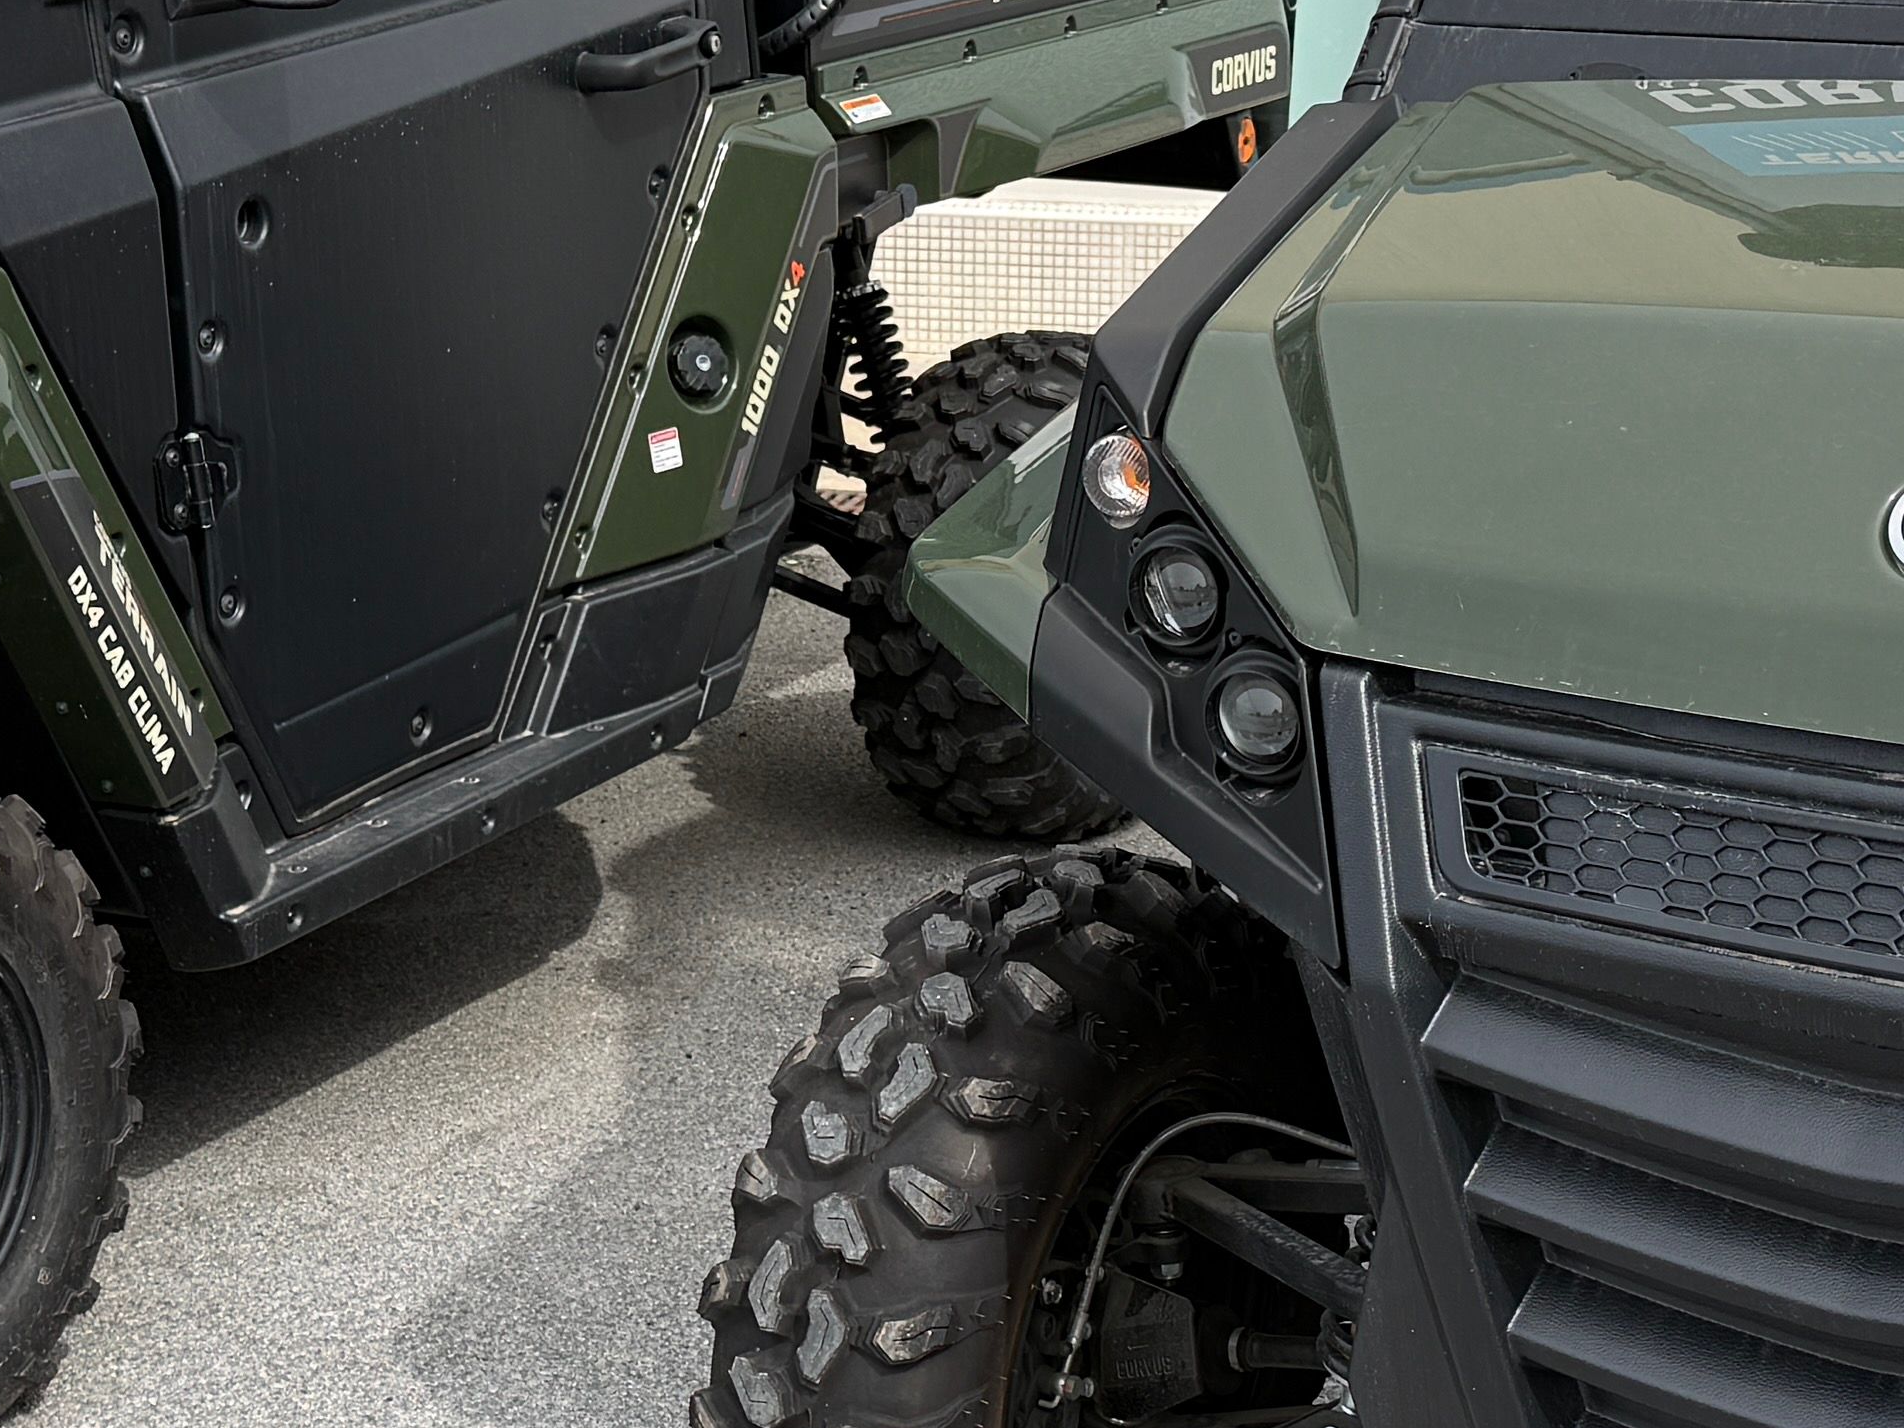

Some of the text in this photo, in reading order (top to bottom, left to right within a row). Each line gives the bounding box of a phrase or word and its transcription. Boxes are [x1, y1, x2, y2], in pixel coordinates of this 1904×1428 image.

[1211, 45, 1277, 96] CORVUS
[741, 260, 806, 437] 1000 DX4
[67, 564, 176, 775] DX4 CAB CLIMA
[92, 508, 193, 737] TERRAIN
